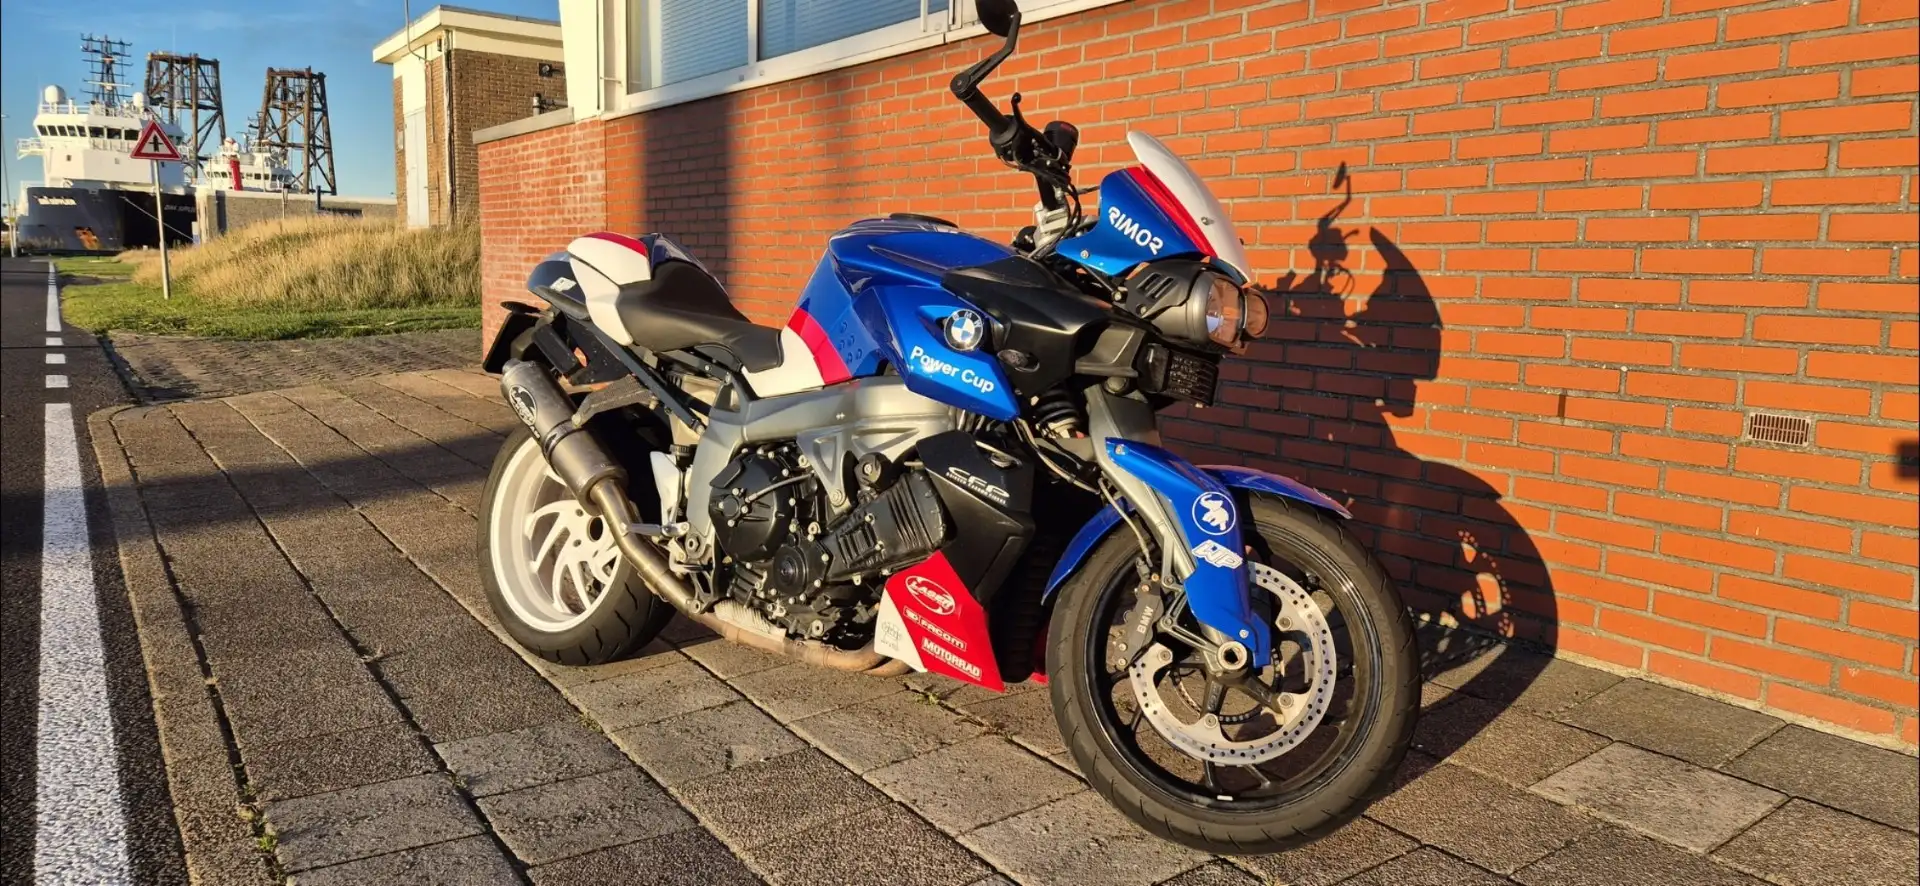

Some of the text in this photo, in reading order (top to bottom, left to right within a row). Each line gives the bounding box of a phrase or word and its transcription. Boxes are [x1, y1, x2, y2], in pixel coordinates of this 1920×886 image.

[1108, 206, 1164, 255] RIMOR
[910, 345, 995, 393] Power Cup
[1136, 605, 1153, 634] BMW
[923, 638, 981, 678] MOTORRAD
